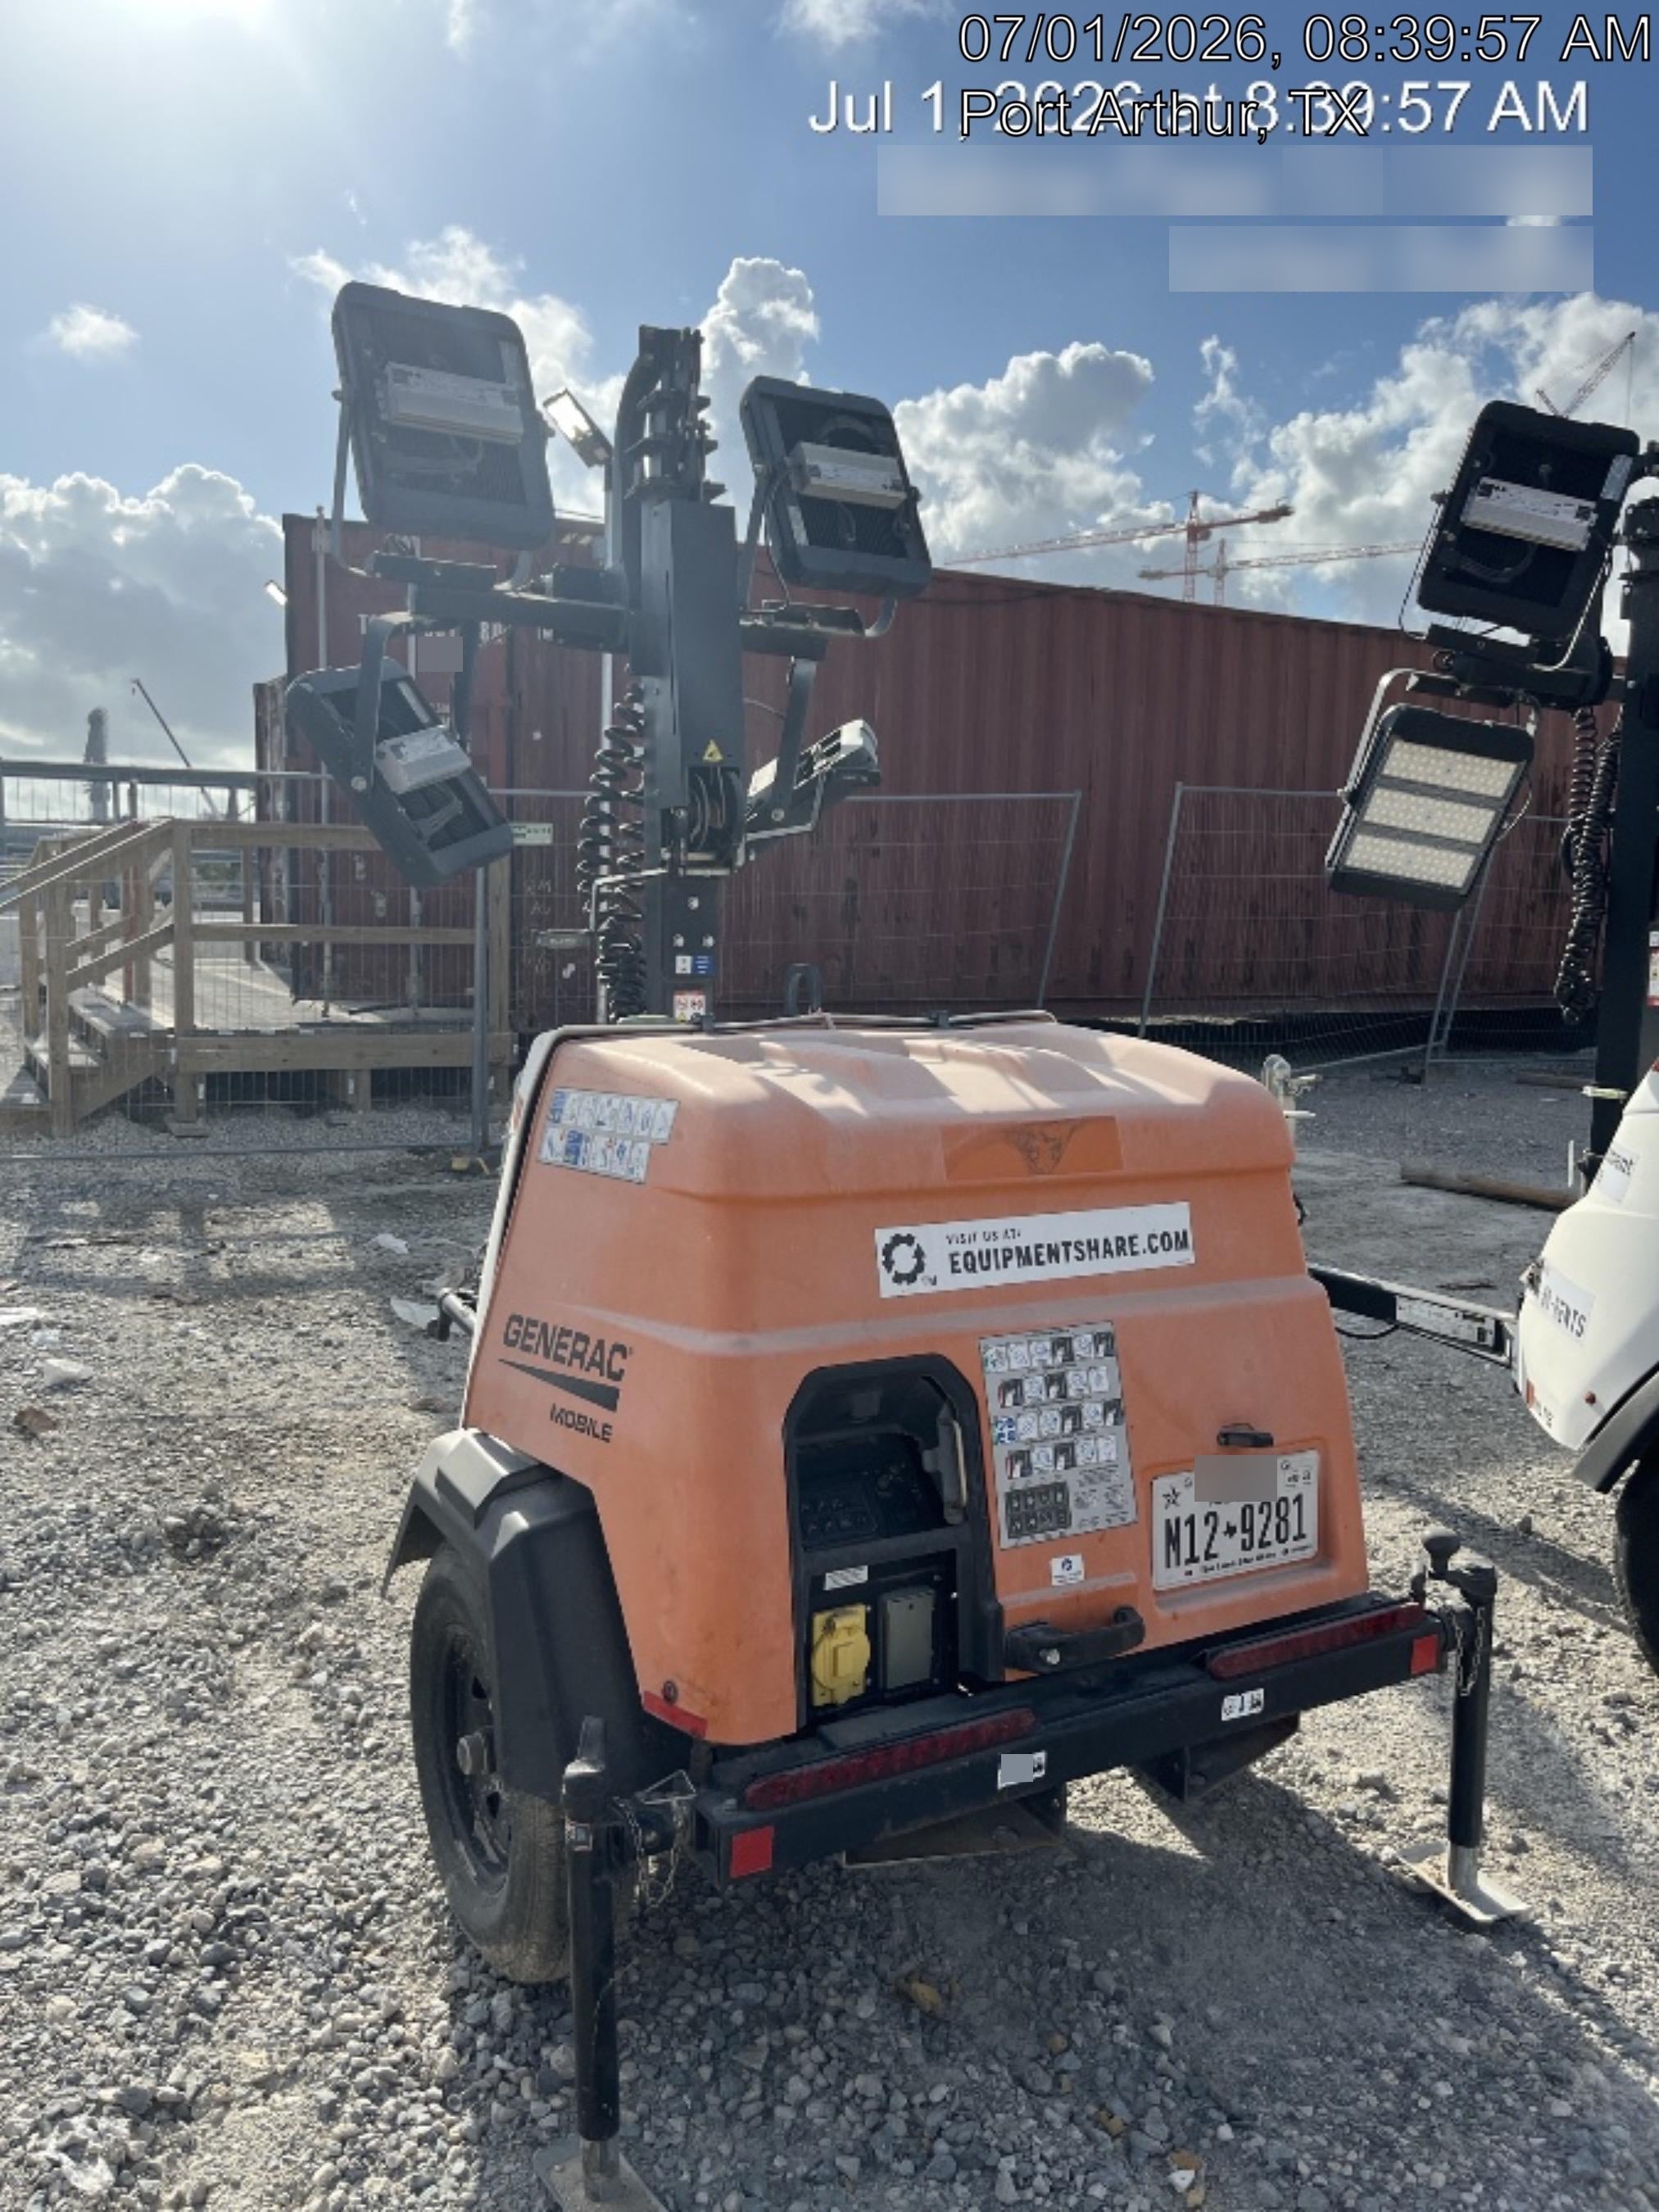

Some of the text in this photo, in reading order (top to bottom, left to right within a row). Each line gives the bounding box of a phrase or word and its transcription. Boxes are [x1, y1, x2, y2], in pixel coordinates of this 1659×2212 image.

[945, 1231, 978, 1245] VISIT
[983, 1230, 999, 1242] US
[948, 1228, 1190, 1275] EQUIPMENTSHARE.COM
[503, 1313, 628, 1382] GENERAC
[549, 1402, 614, 1444] MOBILE
